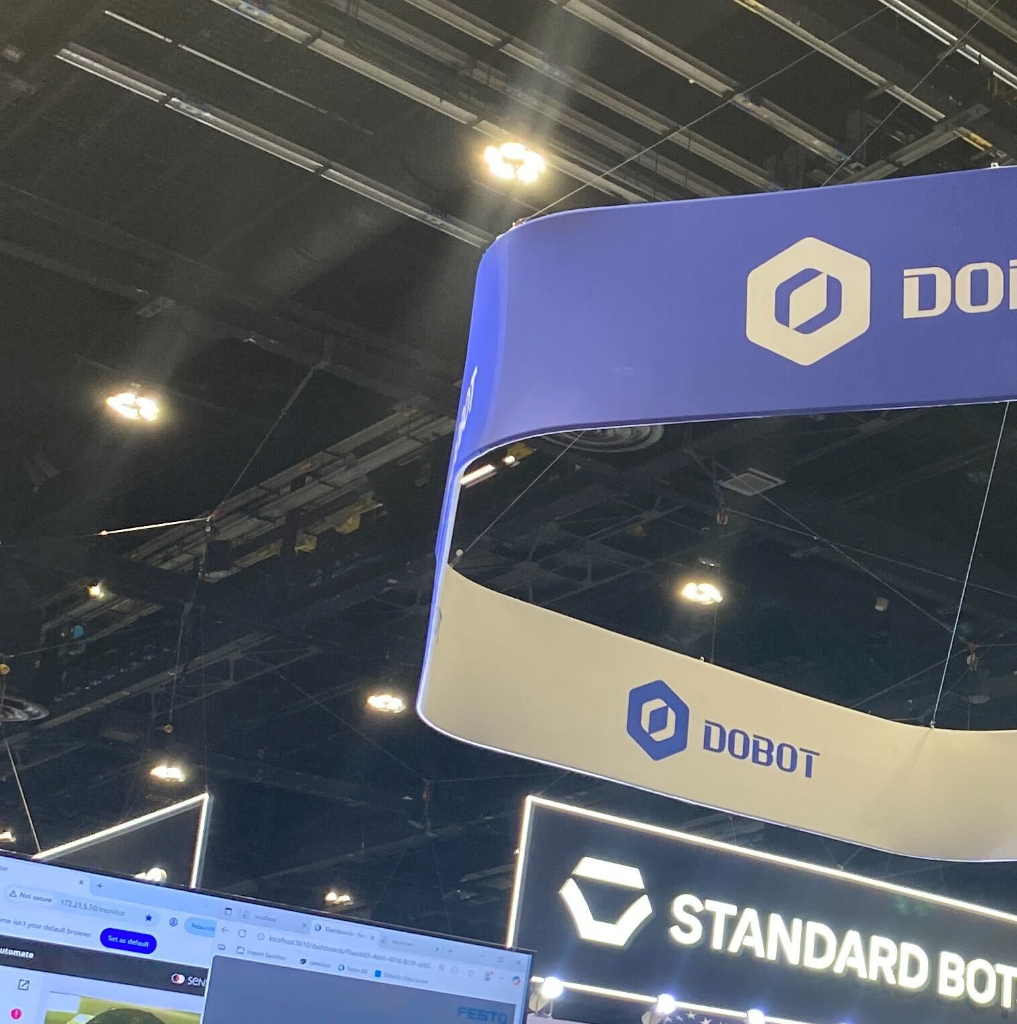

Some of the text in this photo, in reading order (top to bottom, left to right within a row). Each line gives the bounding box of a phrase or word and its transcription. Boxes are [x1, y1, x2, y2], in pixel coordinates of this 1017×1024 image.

[703, 719, 821, 779] DOBOT
[667, 893, 930, 990] STANDARD
[457, 1006, 508, 1024] FESTO
